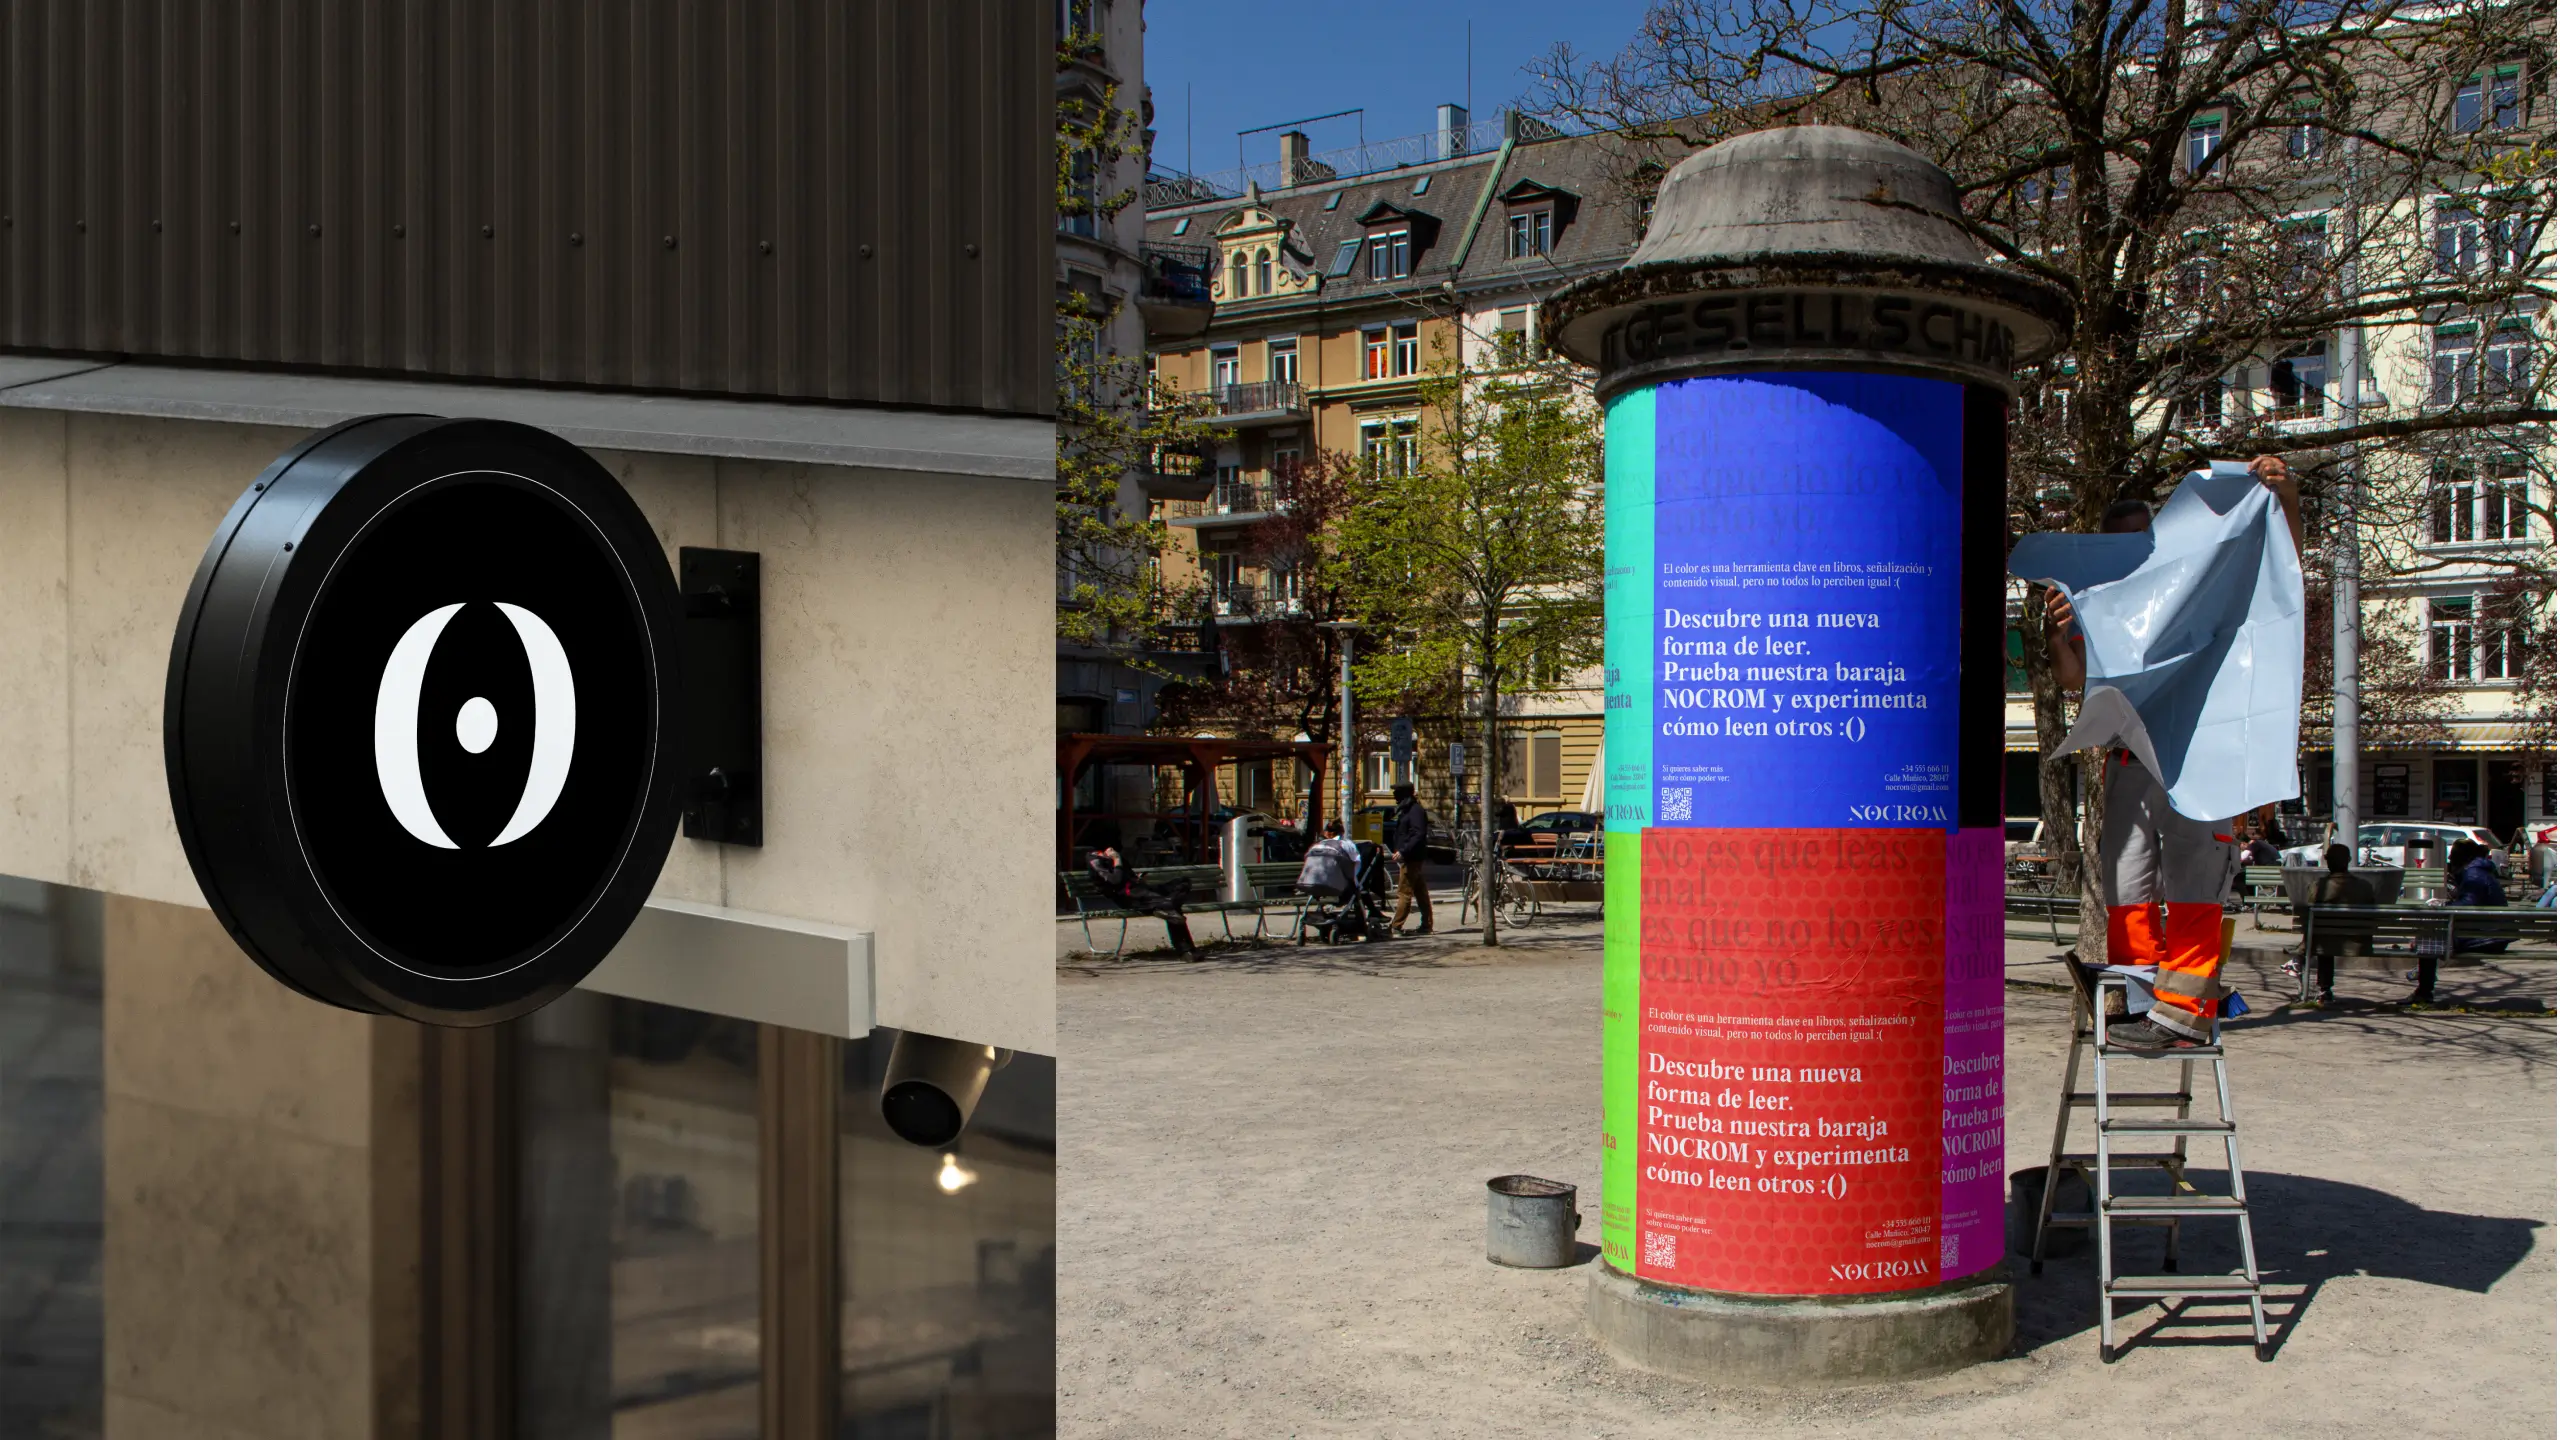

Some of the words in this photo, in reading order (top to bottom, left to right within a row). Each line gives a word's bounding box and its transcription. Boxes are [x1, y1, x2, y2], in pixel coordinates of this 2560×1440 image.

[1664, 563, 1673, 574] El
[1675, 563, 1699, 573] color
[1701, 565, 1710, 573] es
[1733, 561, 1790, 572] herramienta
[1793, 561, 1817, 572] clave
[1819, 564, 1831, 572] en
[1833, 561, 1864, 573] libros,
[1866, 562, 1925, 573] señalización
[1663, 576, 1708, 588] contenido
[1710, 576, 1740, 587] visual,
[1743, 578, 1764, 589] pero
[1767, 578, 1779, 586] no
[1782, 575, 1809, 586] todos
[1811, 575, 1821, 586] lo
[1823, 576, 1864, 588] perciben
[1867, 576, 1891, 589] igual
[1664, 608, 1761, 628] Descubre
[1768, 613, 1809, 628] una
[1816, 613, 1880, 628] nueva
[1663, 636, 1727, 655] forma
[1734, 636, 1758, 655] de
[1765, 635, 1810, 655] leer.
[1664, 662, 1739, 681] Prueba
[1747, 664, 1828, 681] nuestra
[1835, 661, 1906, 686] baraja
[1663, 688, 1766, 708] NOCROM
[1772, 695, 1785, 712] y
[1791, 688, 1927, 713] experimenta
[1663, 716, 1719, 736] cómo
[1725, 716, 1768, 736] leen
[1775, 719, 1833, 736] otros
[1669, 766, 1691, 774] quieres
[1698, 774, 1716, 783] poder
[1849, 805, 1947, 821] NOCROM
[1706, 839, 1742, 869] es
[1754, 839, 1821, 880] que
[1836, 830, 1908, 870] leas
[1687, 916, 1751, 956] que
[1766, 917, 1812, 949] no
[1827, 906, 1862, 948] lo
[1641, 951, 1740, 985] como
[1649, 1007, 1658, 1018] El
[1660, 1009, 1684, 1021] color
[1686, 1013, 1695, 1021] es
[1697, 1014, 1714, 1023] una
[1717, 1013, 1774, 1026] herramienta
[1776, 1015, 1800, 1026] clave
[1802, 1018, 1814, 1026] en
[1816, 1015, 1846, 1026] libros,
[1849, 1014, 1908, 1026] señalización
[1648, 1024, 1692, 1035] contenido
[1695, 1026, 1724, 1038] visual,
[1727, 1031, 1748, 1041] pero
[1751, 1031, 1762, 1040] no
[1765, 1030, 1792, 1040] todos
[1794, 1030, 1804, 1040] lo
[1806, 1029, 1847, 1043] perciben
[1850, 1029, 1874, 1043] igual
[1648, 1052, 1745, 1080] Descubre
[1752, 1067, 1792, 1083] una
[1799, 1068, 1862, 1083] nueva
[1944, 1052, 2000, 1075] Descubre
[1648, 1080, 1711, 1106] forma
[1717, 1088, 1742, 1108] de
[1748, 1089, 1793, 1110] leer.
[1985, 1077, 1999, 1097] de
[1648, 1106, 1723, 1133] Prueba
[1730, 1120, 1811, 1137] nuestra
[1818, 1116, 1888, 1141] baraja
[1943, 1106, 1988, 1129] Prueba
[1647, 1133, 1749, 1163] NOCROM
[1756, 1150, 1767, 1168] y
[1774, 1145, 1910, 1168] experimenta
[1942, 1126, 2001, 1156] NOCROM
[1646, 1163, 1703, 1186] cómo
[1709, 1169, 1751, 1191] leen
[1757, 1176, 1815, 1194] otros
[1979, 1157, 2001, 1178] leen
[1829, 1258, 1928, 1281] NOCROM
